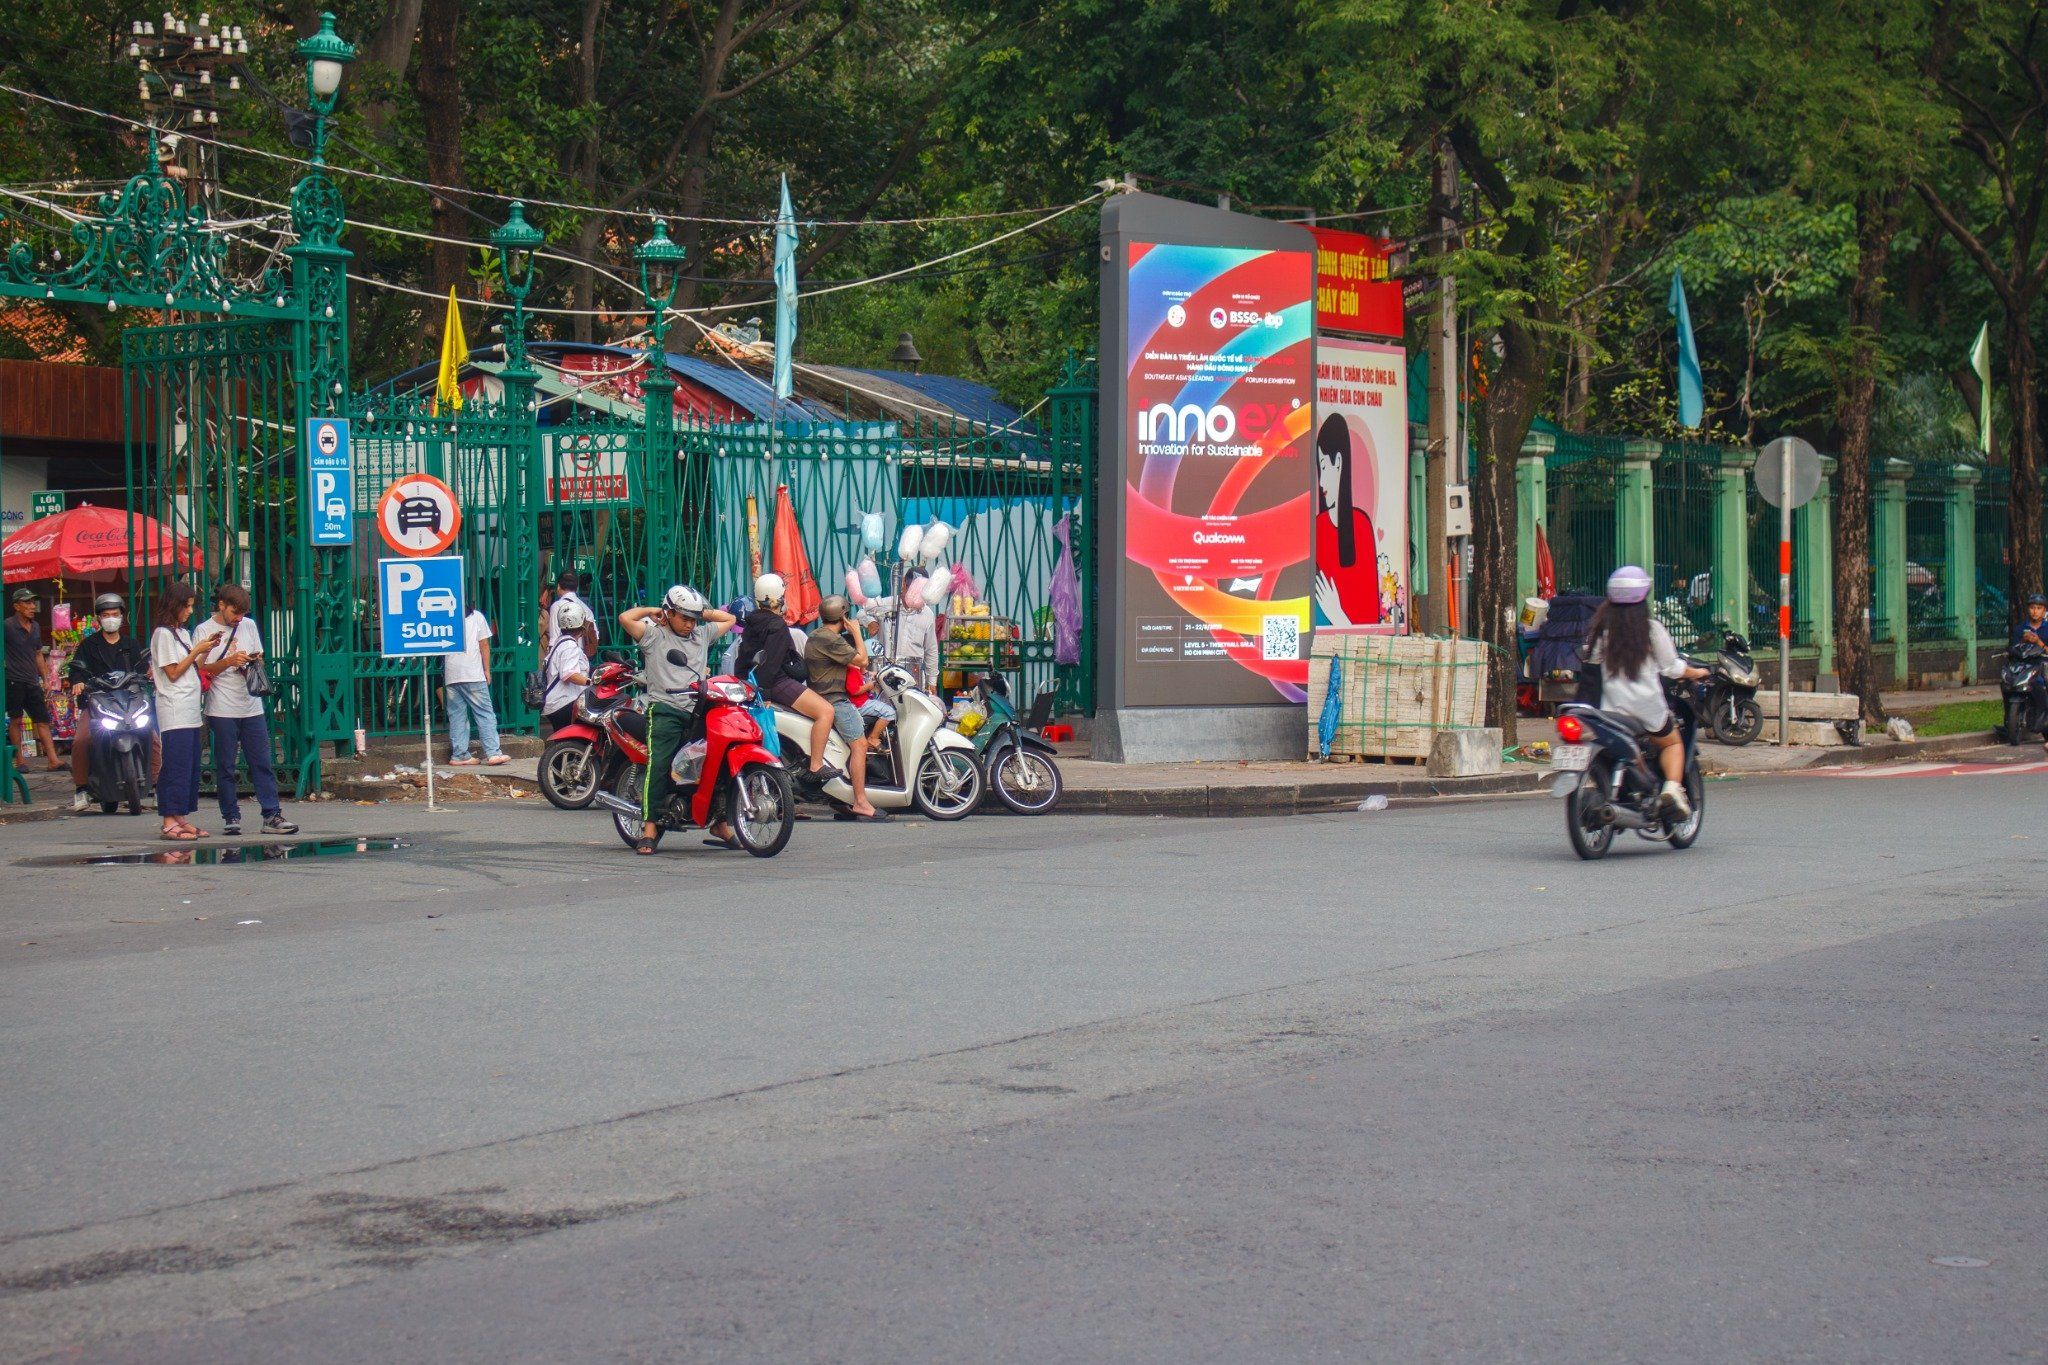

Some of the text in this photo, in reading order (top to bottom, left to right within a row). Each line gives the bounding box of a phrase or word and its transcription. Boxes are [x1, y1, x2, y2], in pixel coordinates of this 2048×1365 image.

[1341, 283, 1359, 316] GIỎI
[1139, 443, 1188, 455] Innovation
[1192, 444, 1206, 455] for
[1208, 444, 1263, 456] Sustainable
[317, 472, 335, 512] P
[324, 523, 341, 531] 50m
[76, 528, 136, 543] Coca-Col
[1193, 531, 1246, 545] Qualcomm
[387, 563, 424, 615] P
[401, 621, 454, 638] 50m
